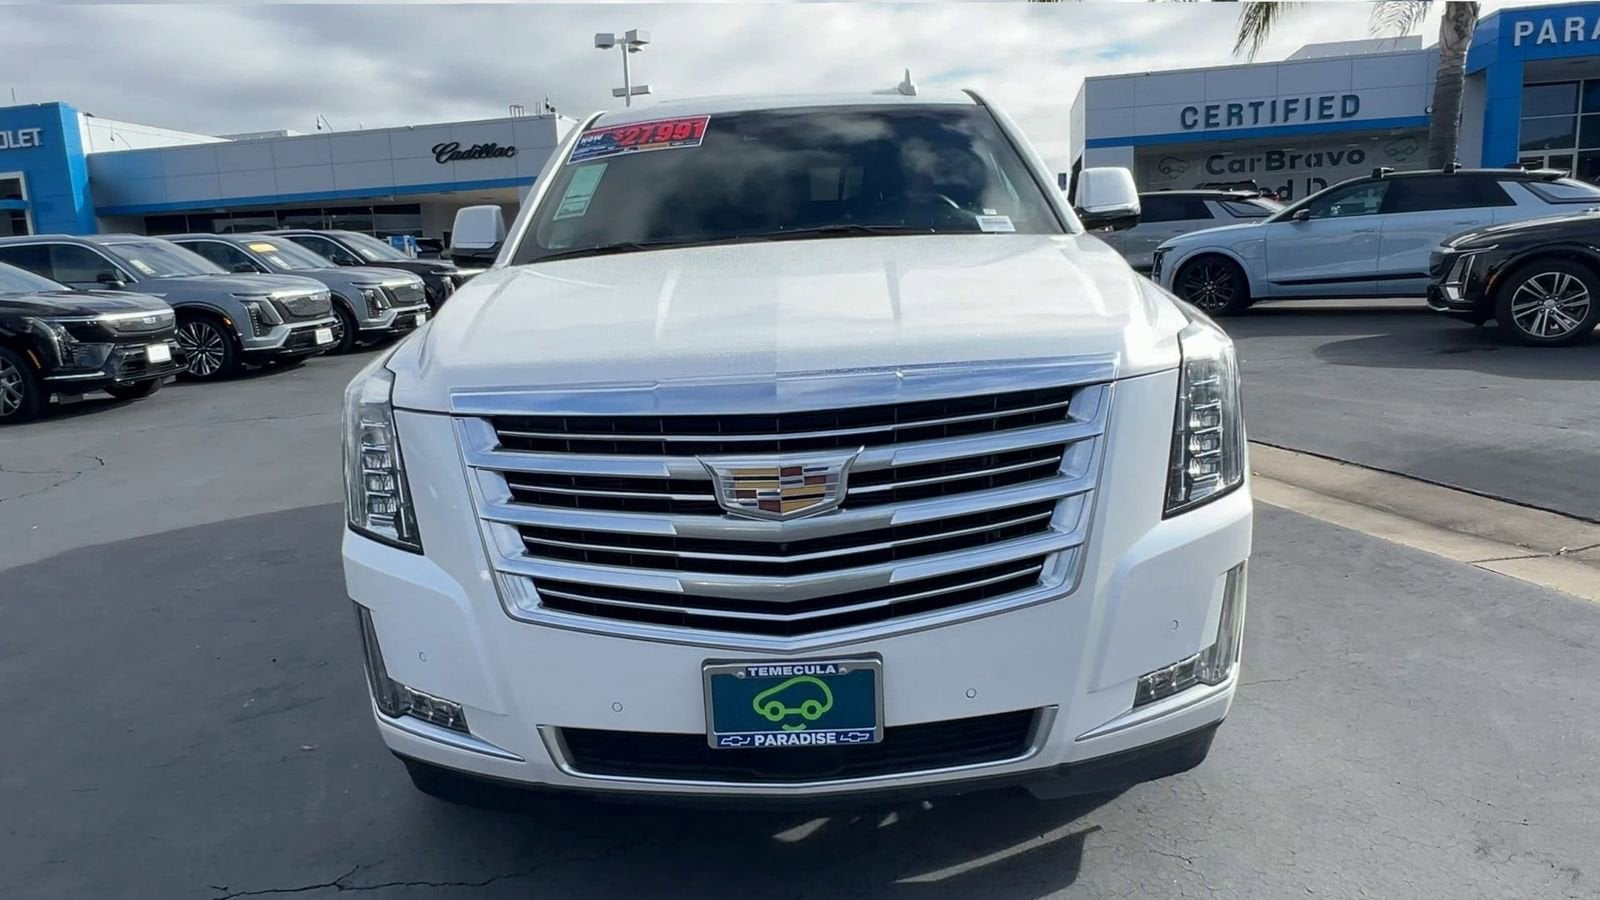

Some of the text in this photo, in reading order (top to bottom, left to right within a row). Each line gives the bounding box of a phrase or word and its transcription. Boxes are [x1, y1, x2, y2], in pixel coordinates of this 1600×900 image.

[1181, 94, 1361, 129] CERTIFIED
[615, 121, 704, 145] $27,991
[432, 142, 516, 164] Cadillac
[1205, 149, 1366, 176] CarBravo
[748, 664, 836, 677] TEMECULA
[754, 732, 837, 746] PARADISE
